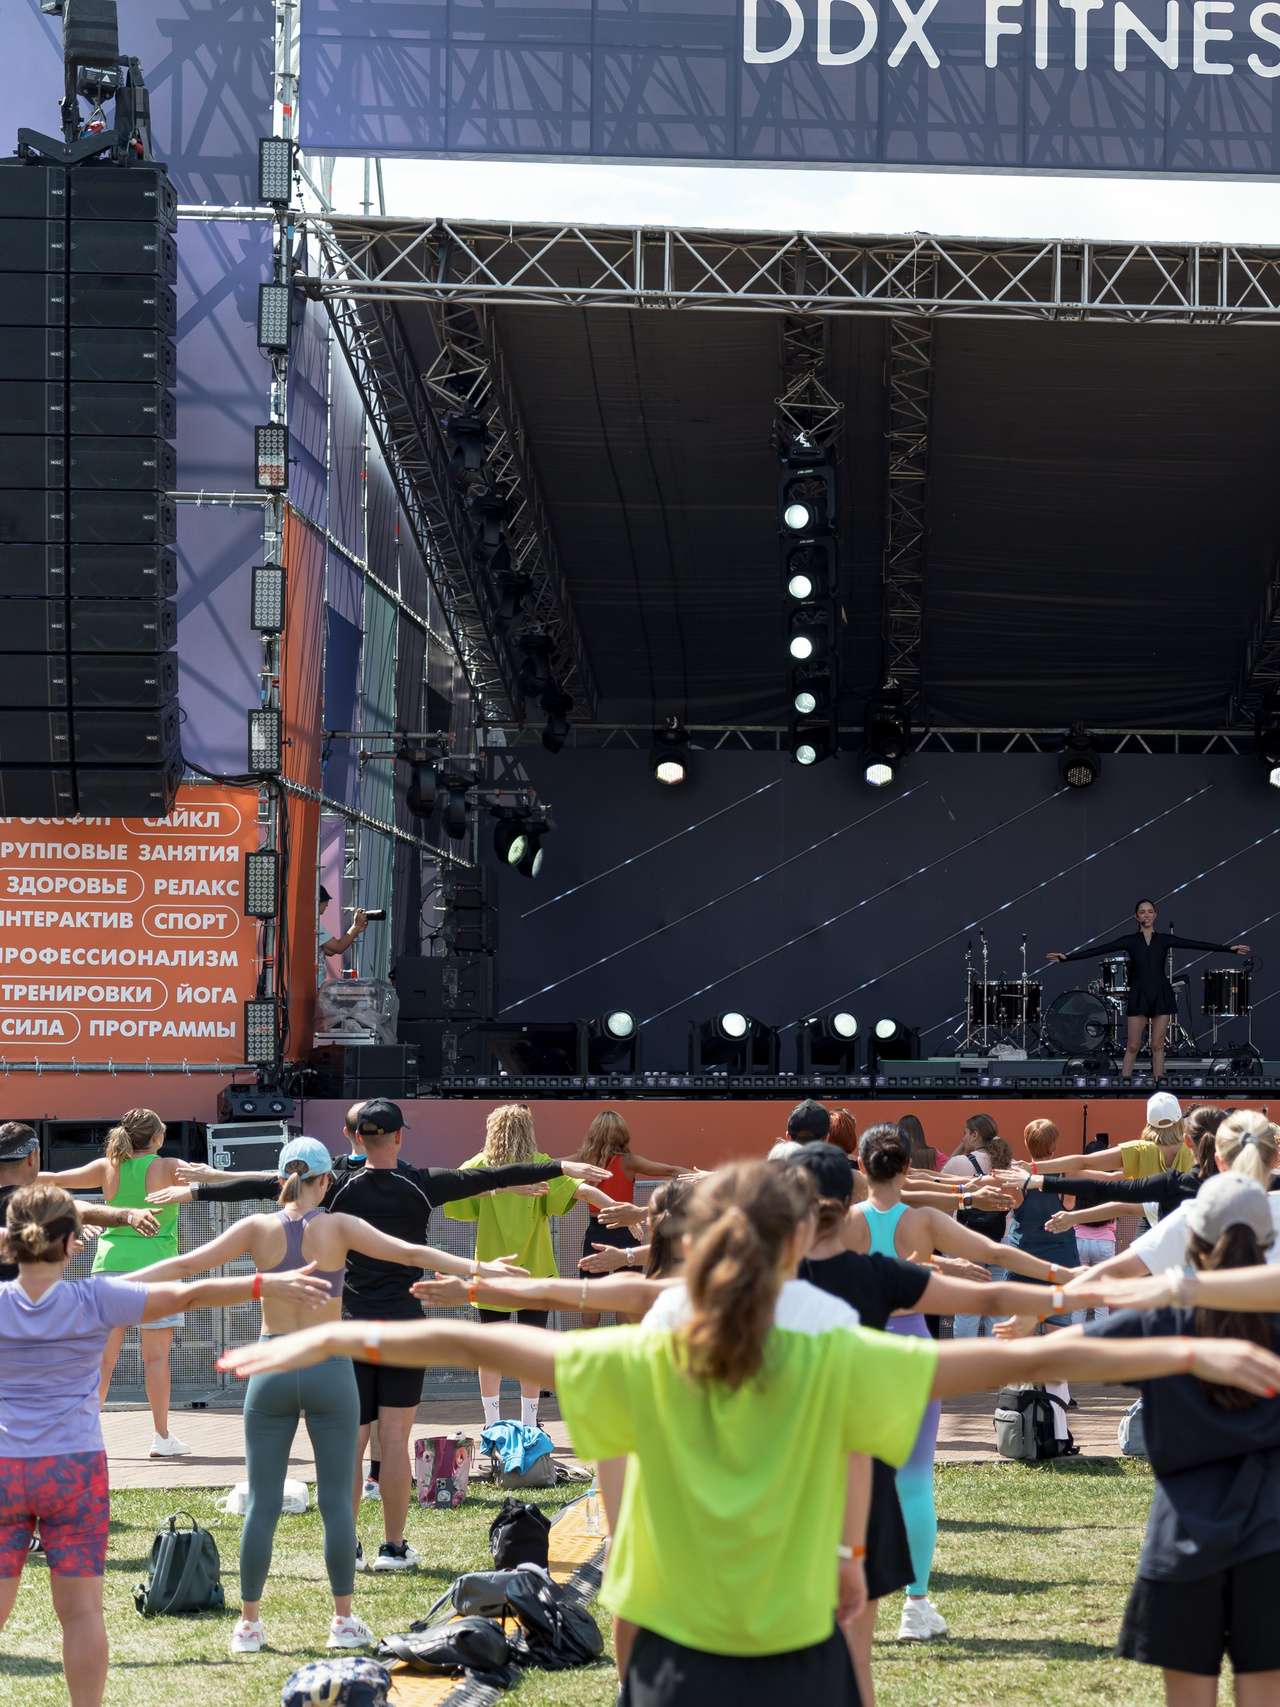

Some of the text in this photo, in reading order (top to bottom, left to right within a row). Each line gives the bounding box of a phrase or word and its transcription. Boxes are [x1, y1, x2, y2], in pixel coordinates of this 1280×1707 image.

[743, 0, 941, 69] DDX
[142, 807, 220, 828] САЙКЛ
[138, 844, 239, 862] ЗАНЯТИЯ
[6, 875, 240, 897] ЗДОРОВЬЕ РЕЛАКС
[0, 910, 228, 930] НТЕРАКТИВ СПОРТ
[0, 947, 239, 967] РОФЕССИОНАЛИЗМ
[1, 983, 238, 1004] ТРЕНИРОВКИ ЙОГА
[1, 1018, 236, 1038] СИЛА ПРОГРАММЫ
